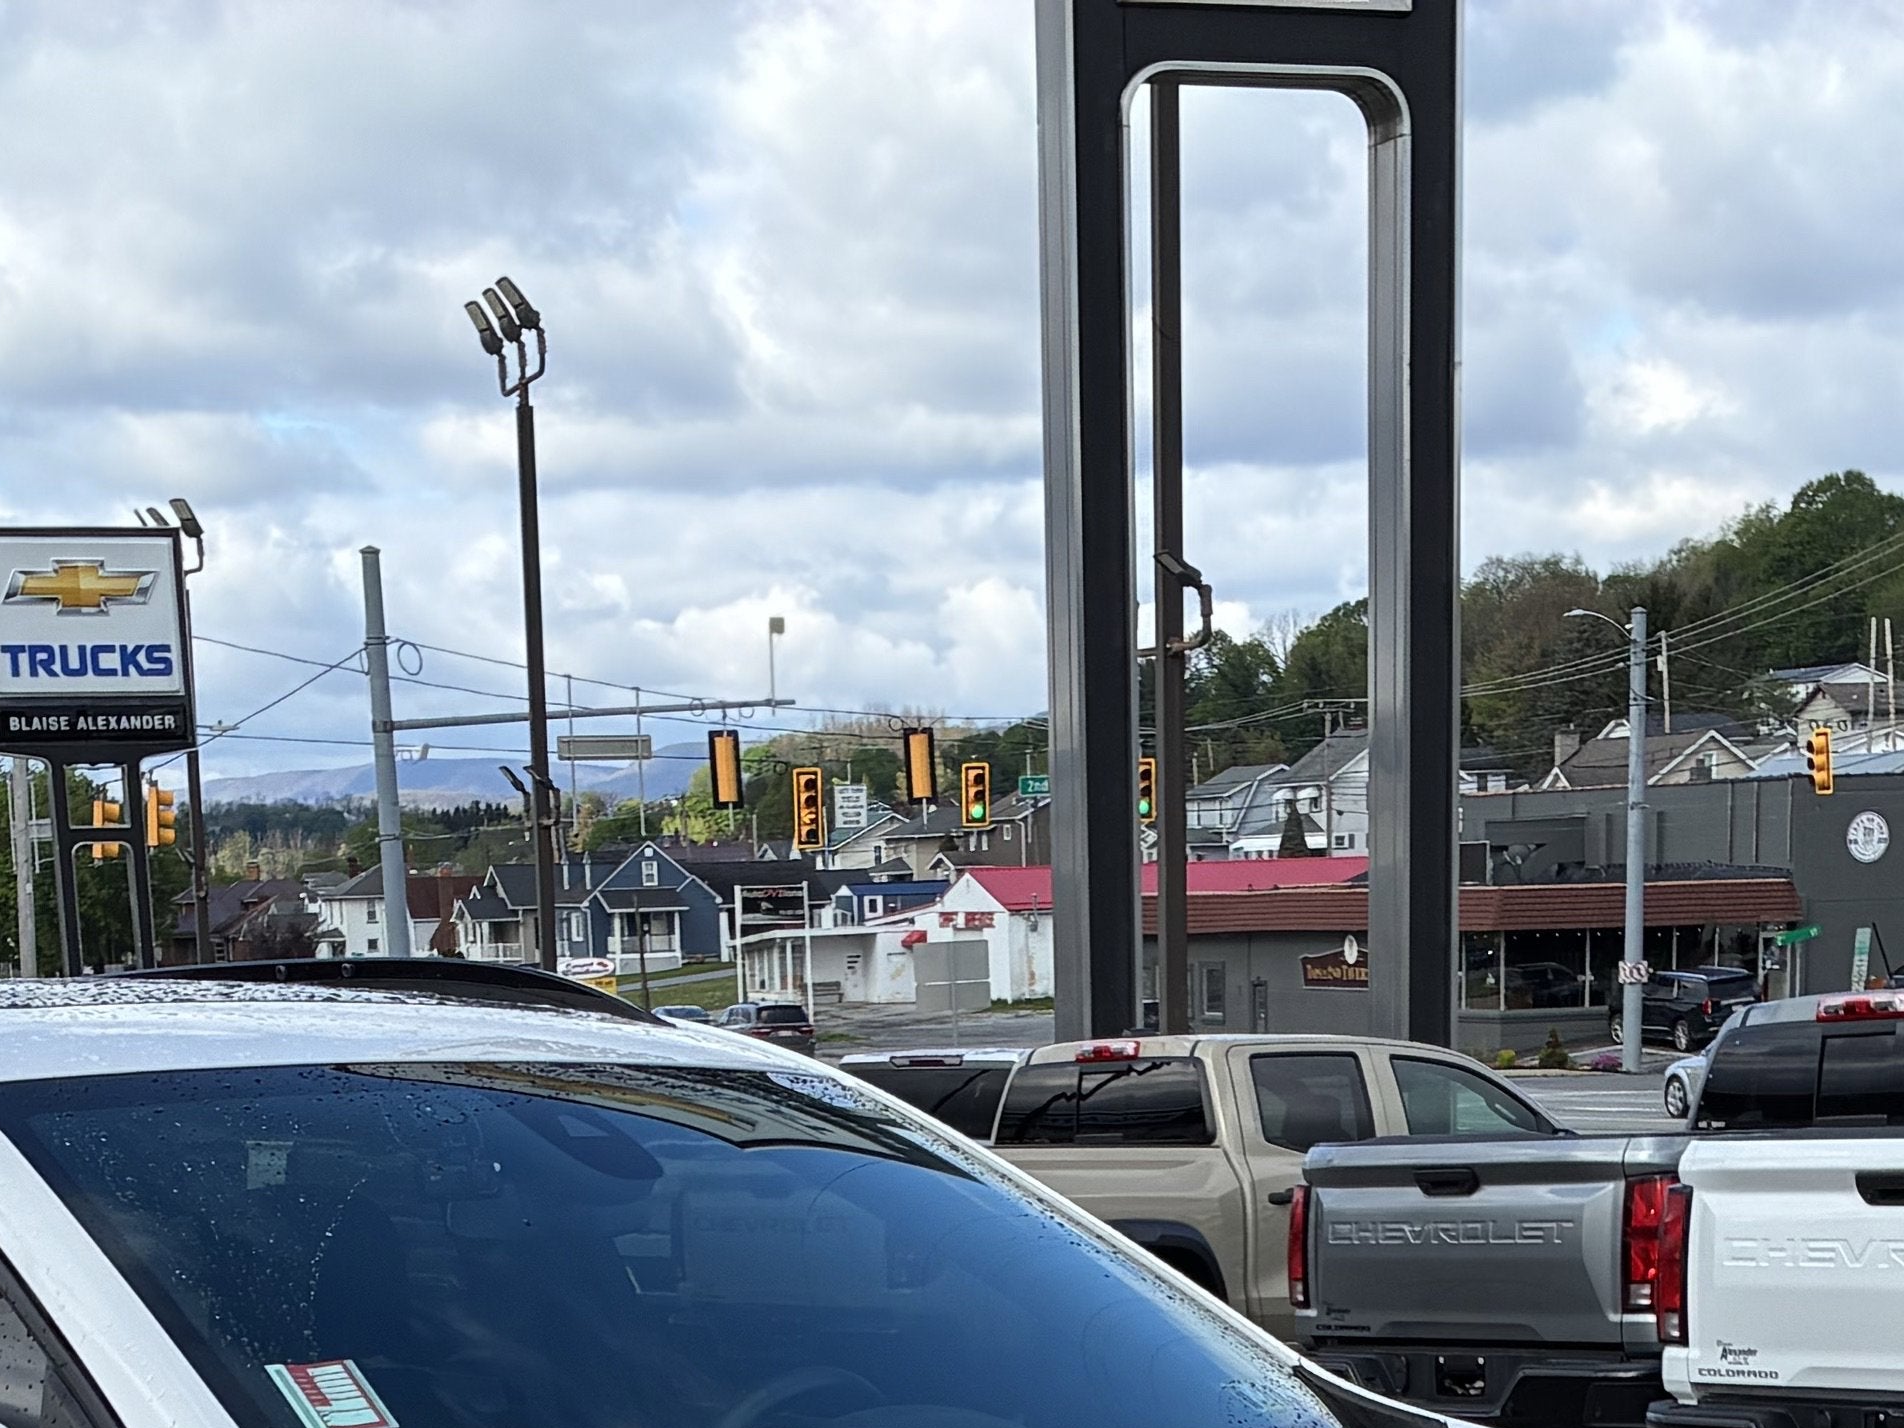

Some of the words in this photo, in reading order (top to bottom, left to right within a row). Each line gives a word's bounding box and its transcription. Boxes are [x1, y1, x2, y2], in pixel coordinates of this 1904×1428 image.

[0, 644, 173, 677] TRUCKS
[9, 716, 70, 731] BLAISE
[76, 714, 175, 731] ALEXANDER
[1327, 1219, 1575, 1246] CHEVROLET
[1698, 1367, 1779, 1380] COLORADO
